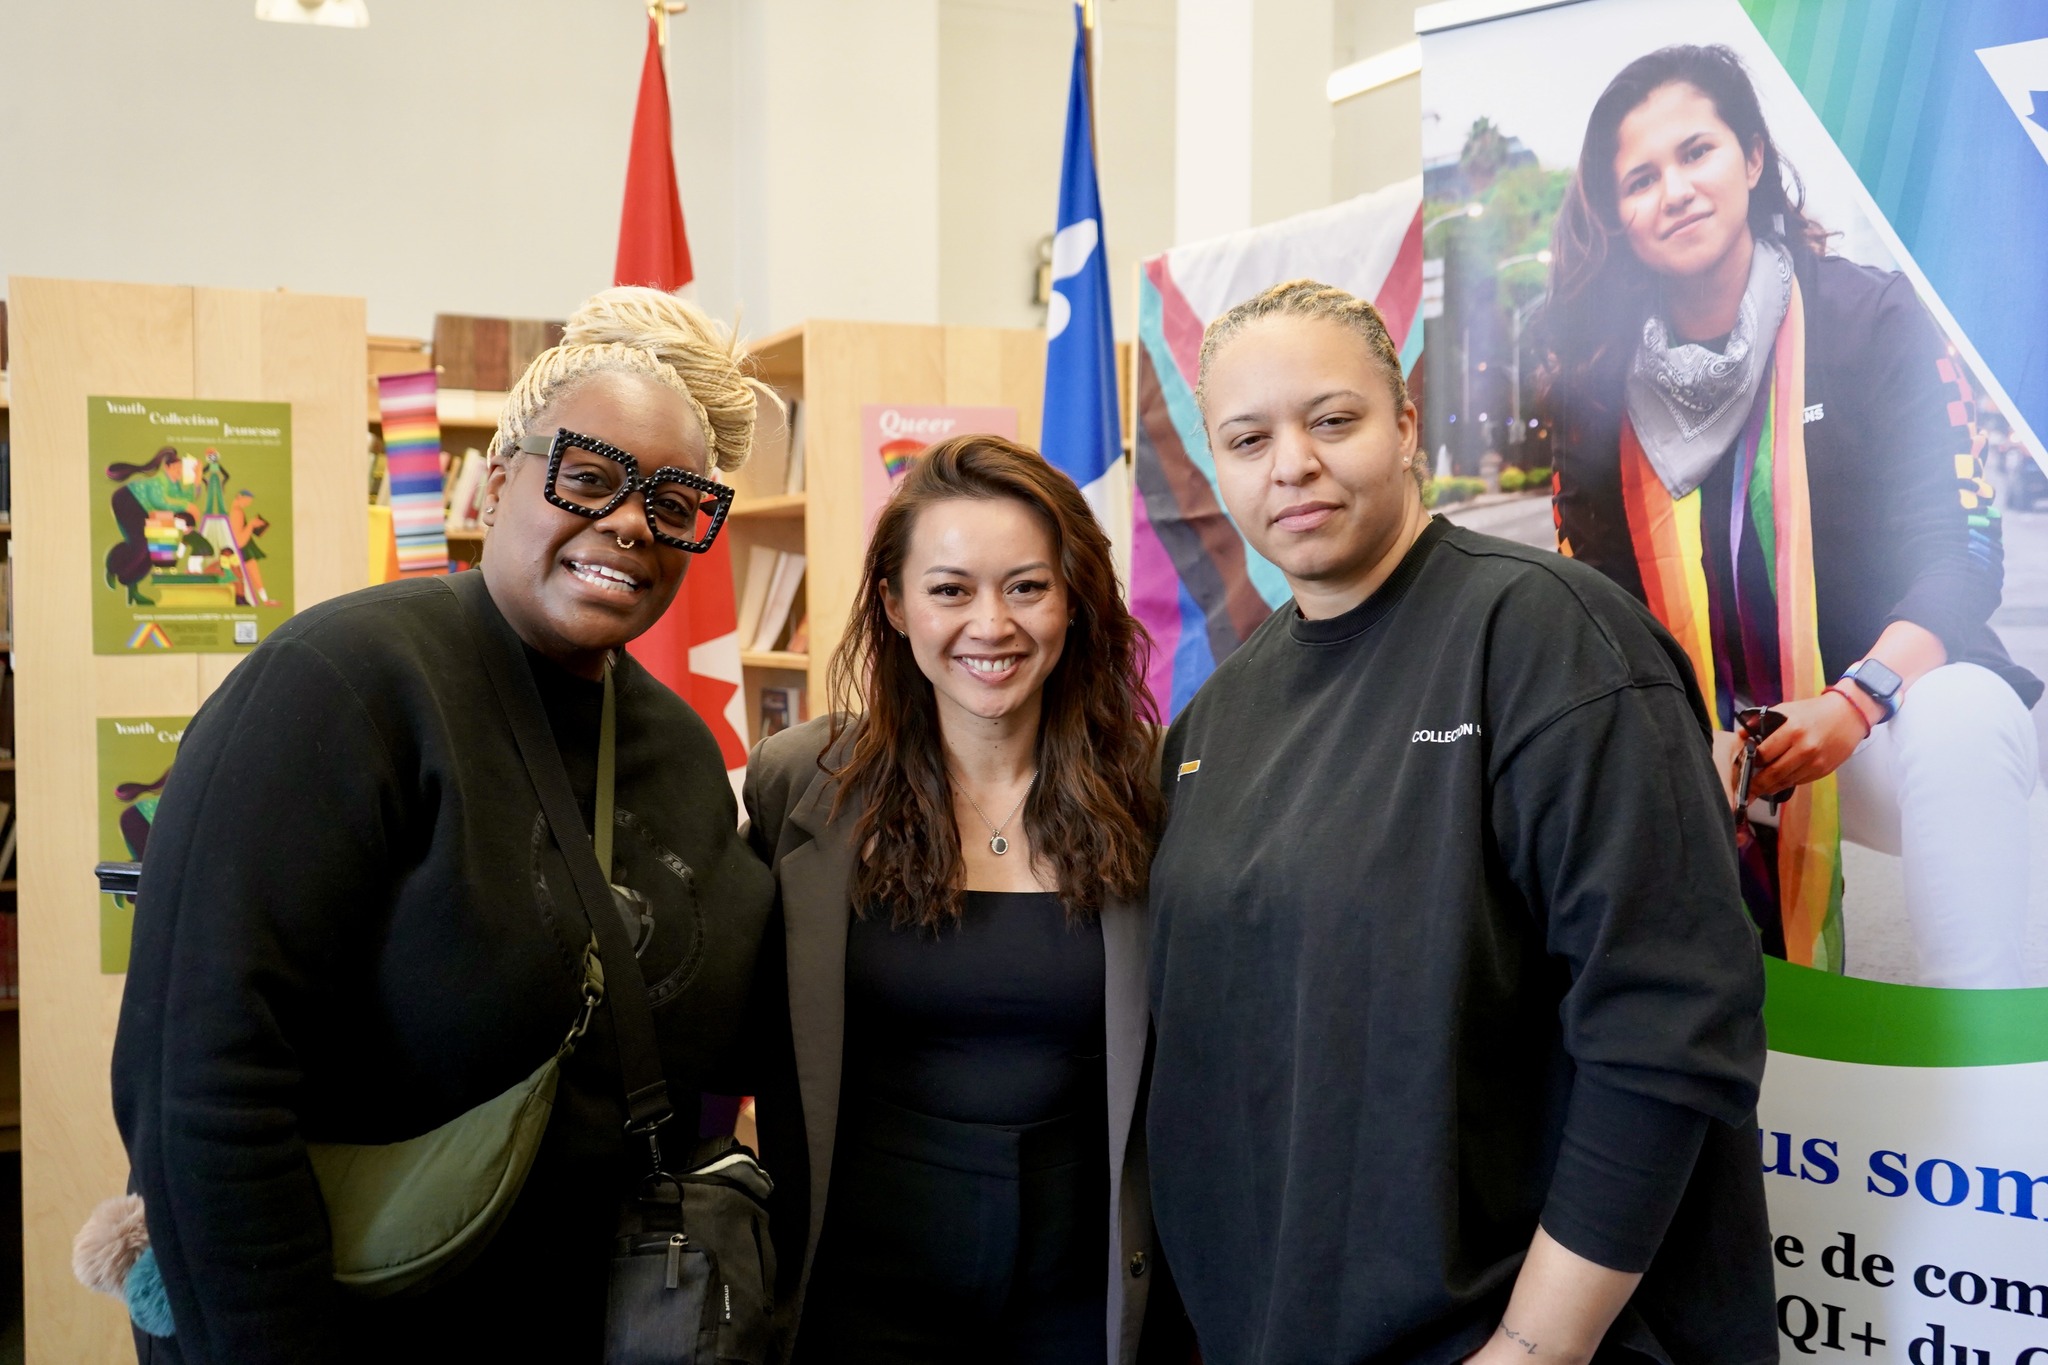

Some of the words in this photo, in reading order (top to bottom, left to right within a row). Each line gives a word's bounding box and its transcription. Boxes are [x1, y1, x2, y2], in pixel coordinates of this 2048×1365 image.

[106, 401, 146, 415] Youth
[149, 411, 219, 427] Collection
[224, 423, 281, 437] Jeunesse
[879, 409, 956, 438] Queer
[115, 722, 155, 736] Youth
[1821, 1231, 1895, 1288] de
[1777, 1294, 1887, 1357] QI+
